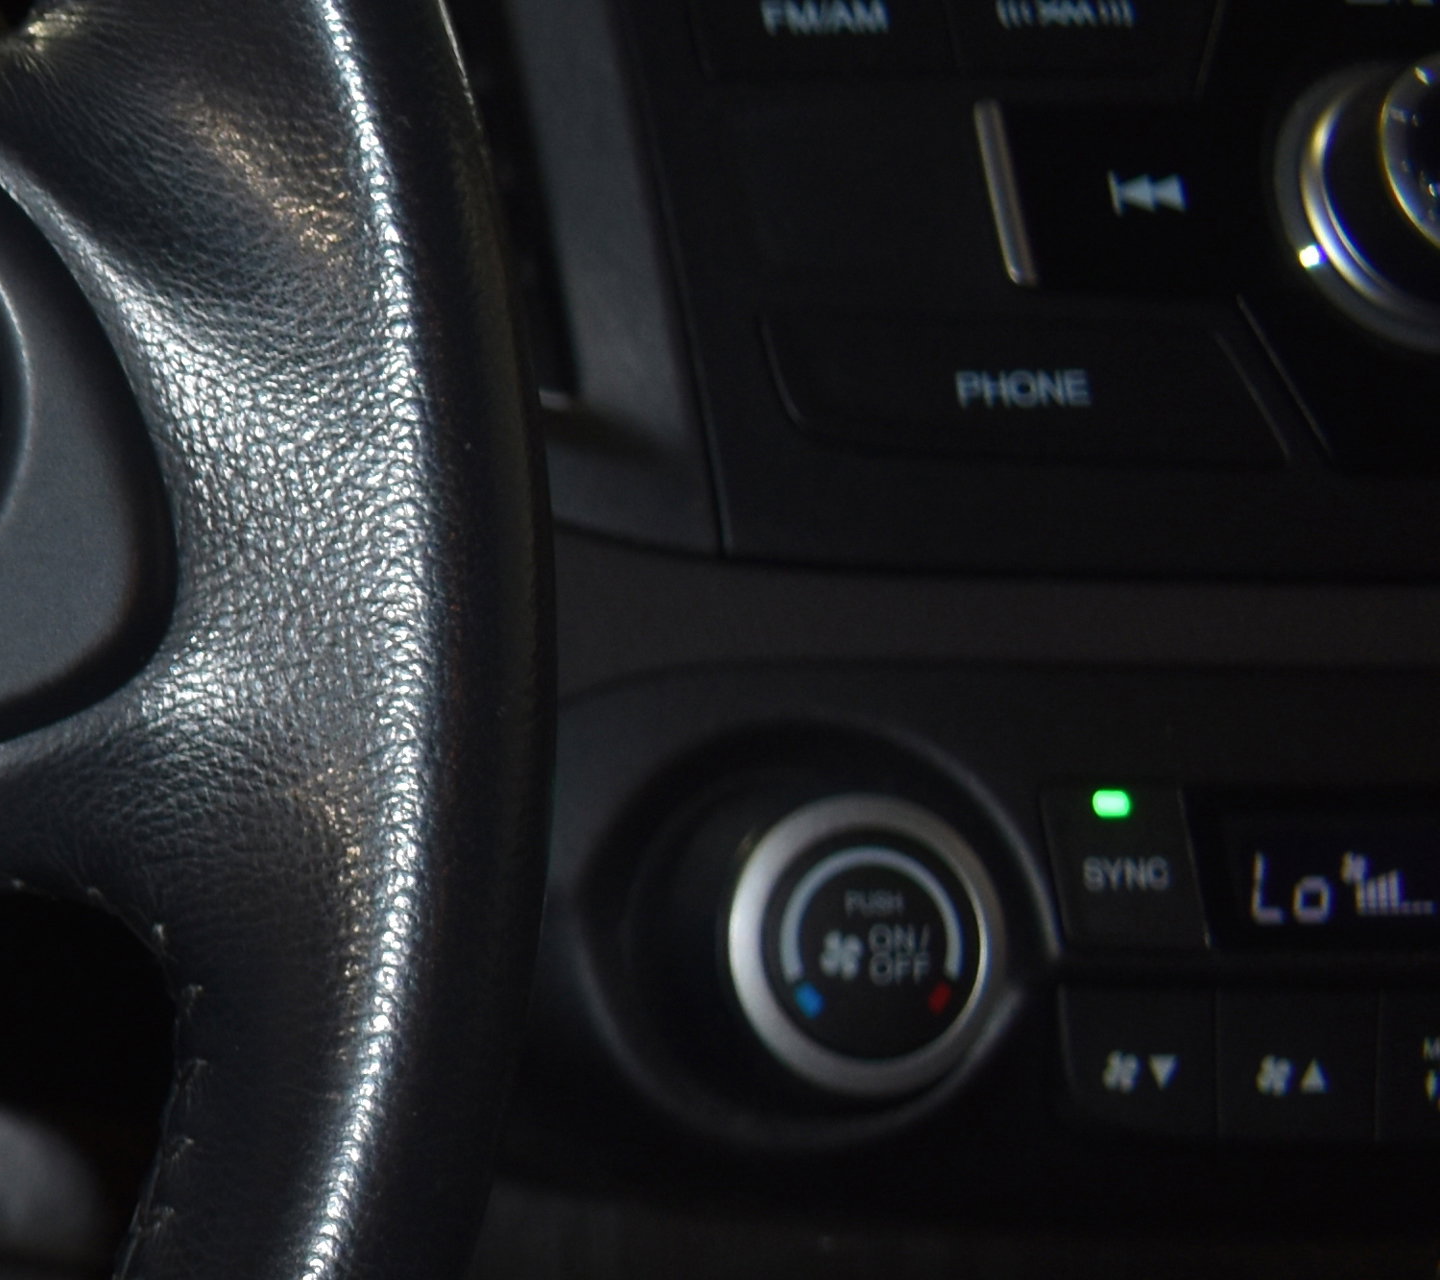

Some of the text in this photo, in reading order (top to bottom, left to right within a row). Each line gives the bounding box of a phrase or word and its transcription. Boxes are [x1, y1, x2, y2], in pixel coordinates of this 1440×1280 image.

[954, 369, 1090, 408] PHONE
[1083, 855, 1170, 891] SYNC
[844, 890, 904, 915] PUSH
[869, 952, 931, 984] OFF
